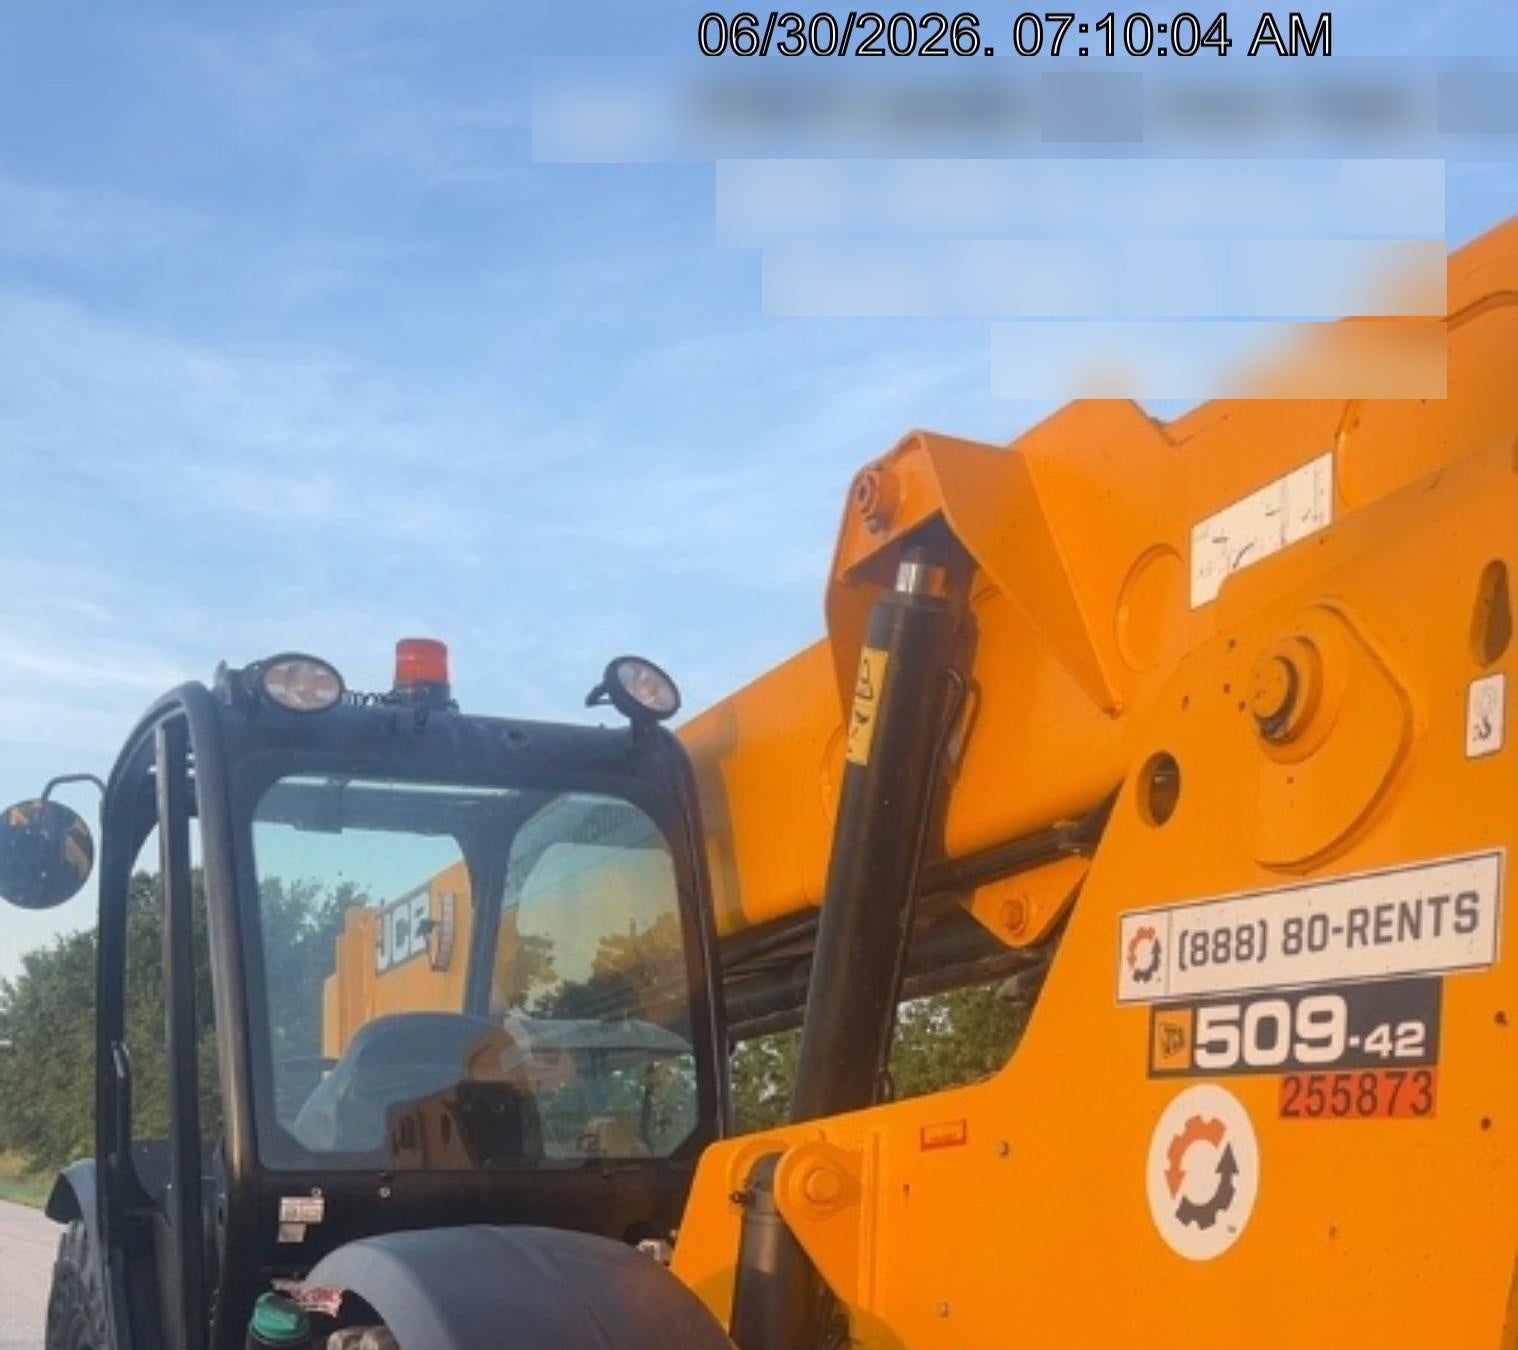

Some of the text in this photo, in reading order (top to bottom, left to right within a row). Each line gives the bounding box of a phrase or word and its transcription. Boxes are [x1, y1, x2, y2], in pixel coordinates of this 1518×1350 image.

[1178, 891, 1480, 971] (888) 80-RENTS
[1194, 994, 1426, 1068] 509-42
[1280, 1070, 1434, 1117] 255873
